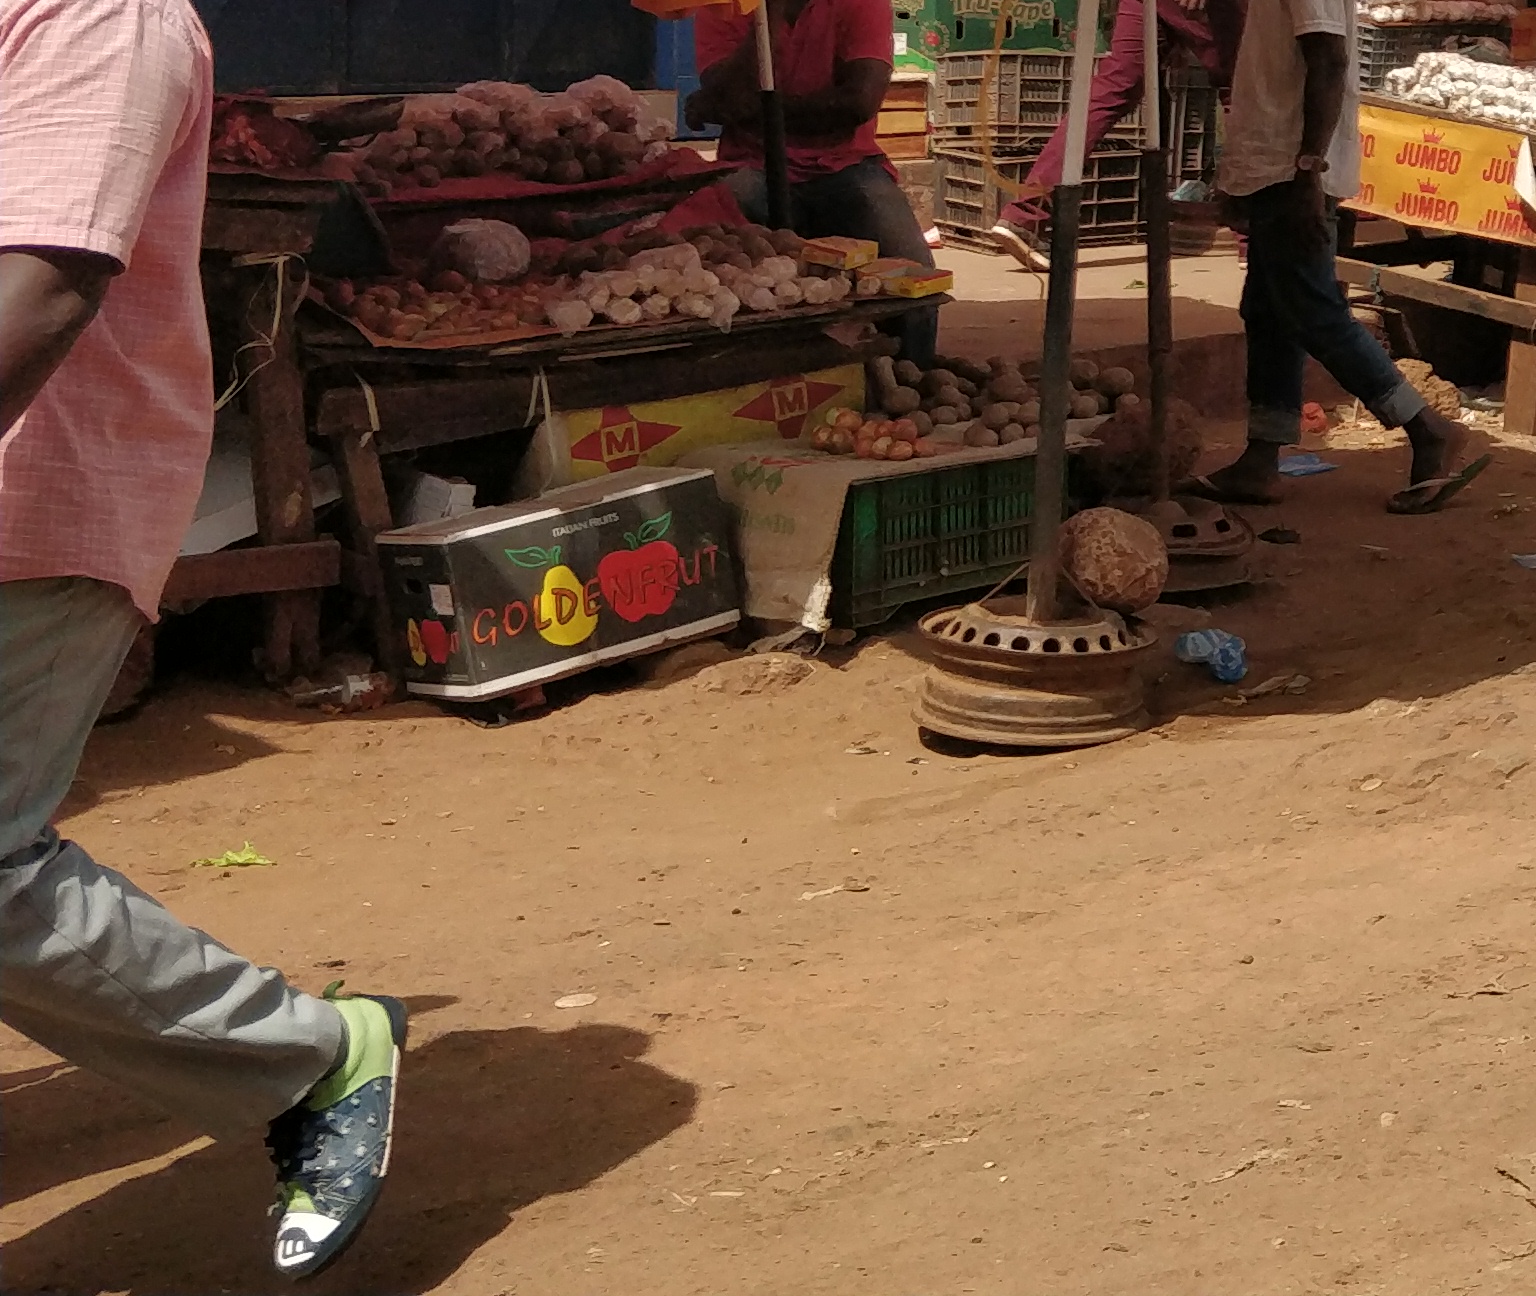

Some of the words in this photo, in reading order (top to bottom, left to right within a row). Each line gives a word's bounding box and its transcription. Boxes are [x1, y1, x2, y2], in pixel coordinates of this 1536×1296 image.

[1396, 141, 1462, 175] JUMBO
[1394, 191, 1460, 225] JUMBO
[774, 389, 803, 417] M
[604, 427, 637, 456] M
[588, 512, 620, 529] FRUITS
